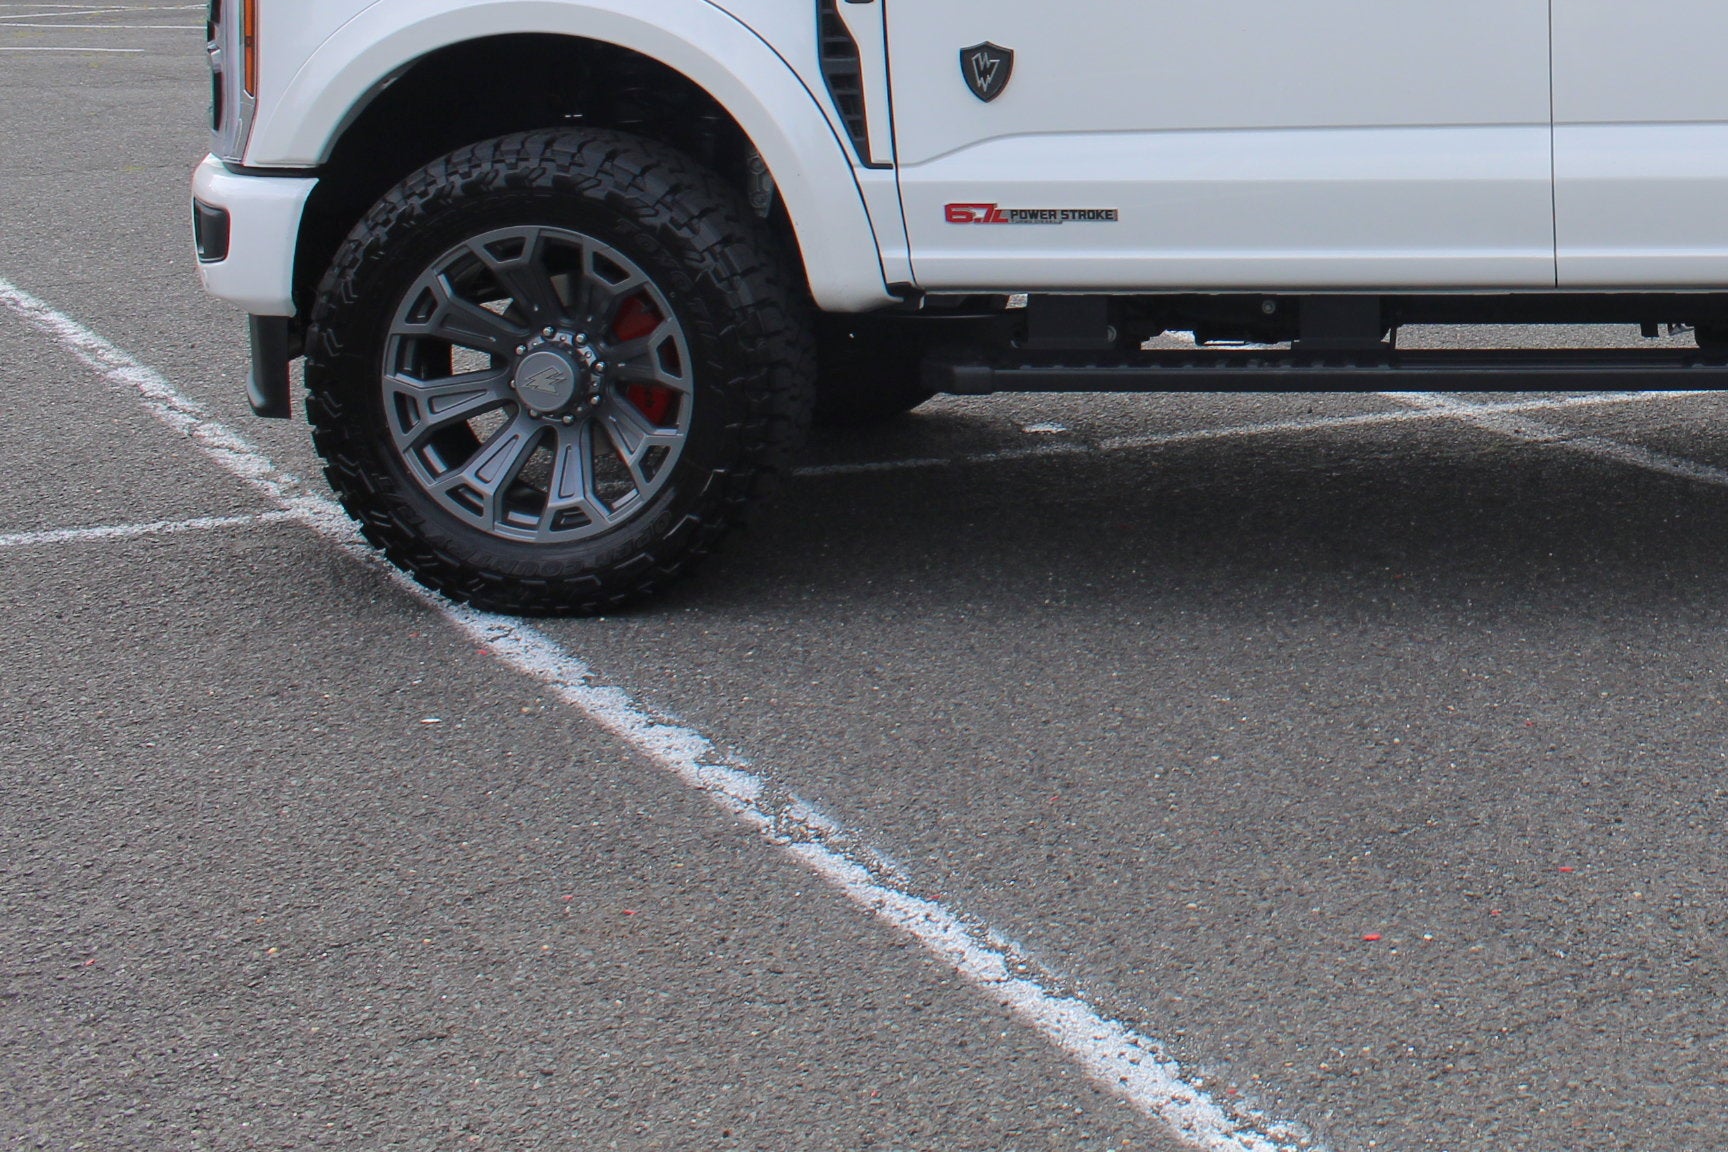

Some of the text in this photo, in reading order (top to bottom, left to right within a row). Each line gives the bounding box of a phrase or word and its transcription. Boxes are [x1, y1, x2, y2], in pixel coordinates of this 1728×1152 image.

[944, 203, 1115, 224] 6.7L POWER STROKE
